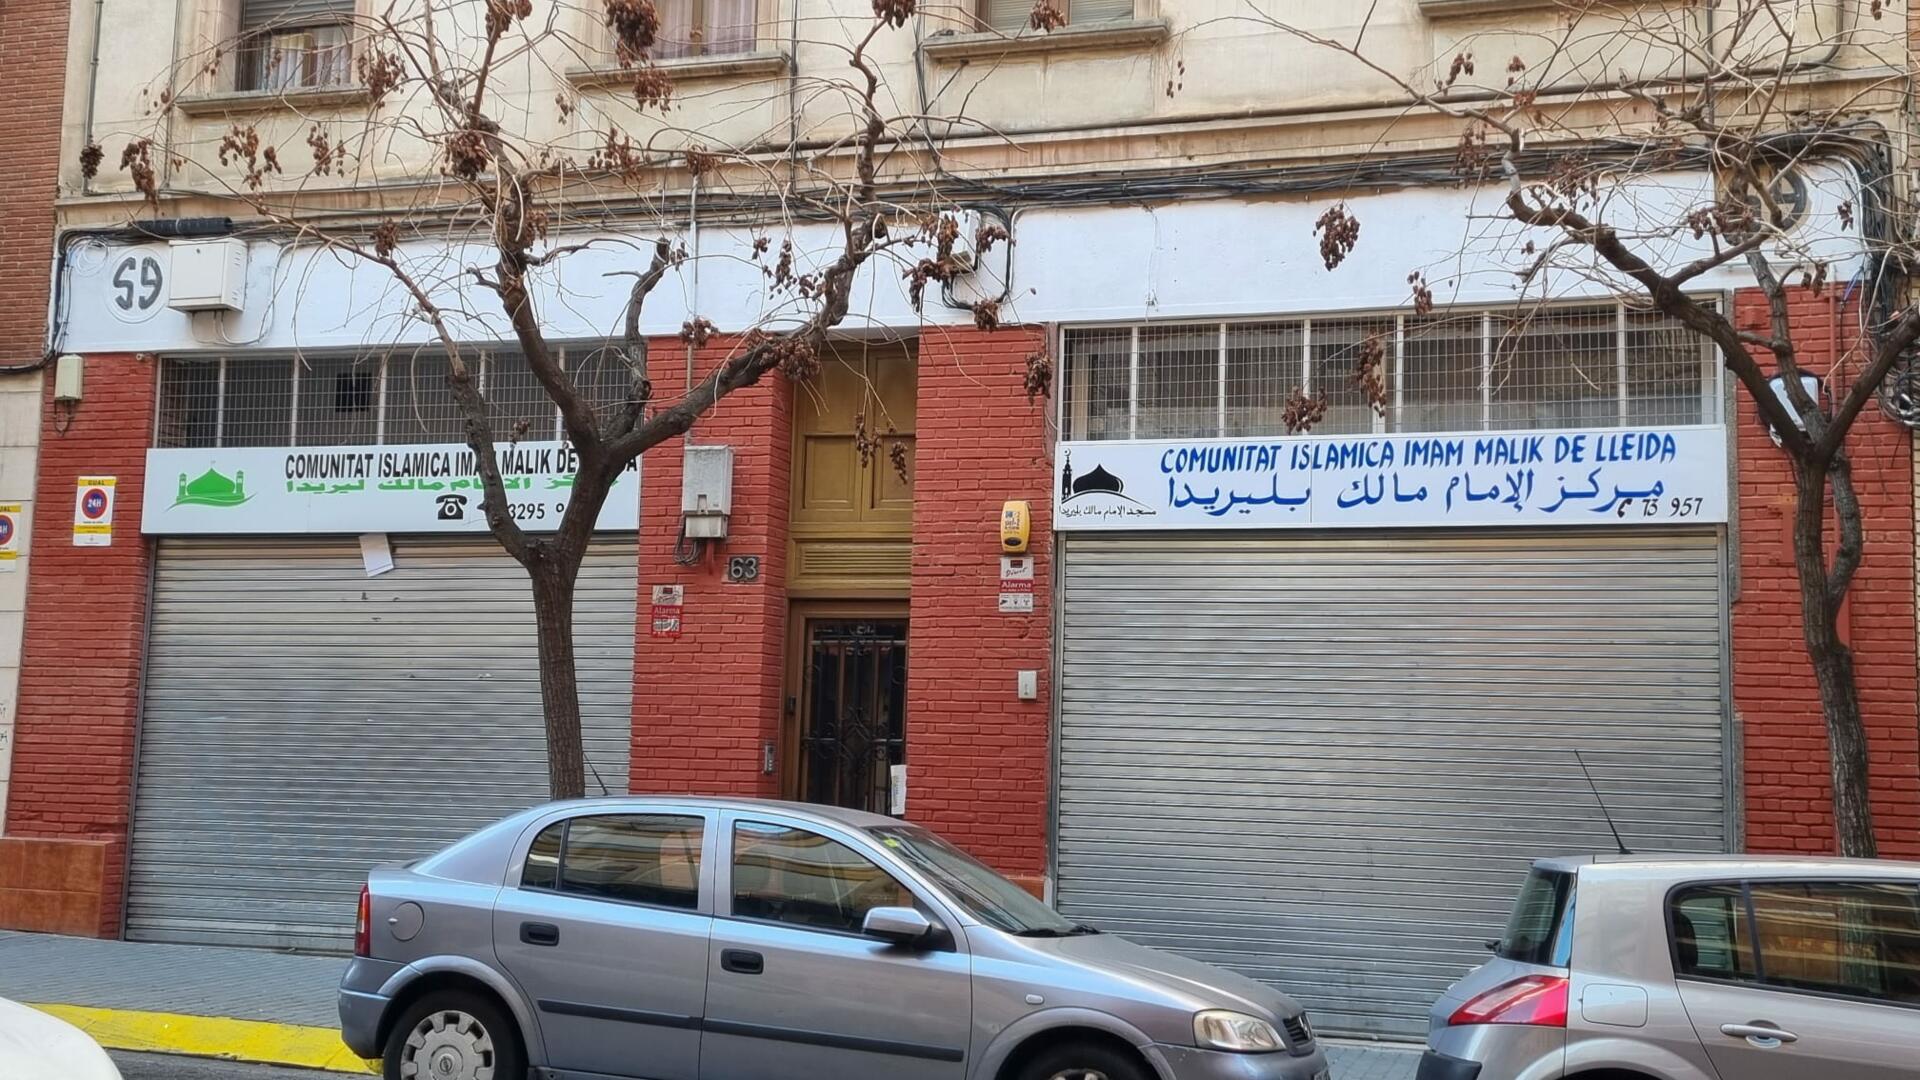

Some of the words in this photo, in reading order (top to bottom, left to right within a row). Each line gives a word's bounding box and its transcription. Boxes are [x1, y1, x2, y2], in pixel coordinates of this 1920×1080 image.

[285, 453, 374, 479] COMUNITAT
[378, 451, 451, 478] ISLAMICA
[455, 450, 497, 477] IM
[501, 448, 551, 475] MALIK
[556, 448, 576, 474] DE
[1160, 444, 1282, 473] COMUNITAT
[1290, 440, 1394, 471] ISLAMICA
[1403, 438, 1464, 468] IMAM
[1473, 435, 1544, 467] MALIK
[1554, 434, 1586, 464] DE
[1595, 432, 1677, 463] LLEIDA
[377, 478, 445, 491] مالك
[1168, 472, 1311, 516] بليريدا
[1337, 472, 1428, 508] مالك
[1446, 468, 1534, 513] الإمام
[1538, 467, 1664, 512] مركز
[87, 498, 102, 508] 24H
[1126, 507, 1157, 517] مسجد
[1670, 497, 1703, 516] 957
[731, 557, 757, 579] 63
